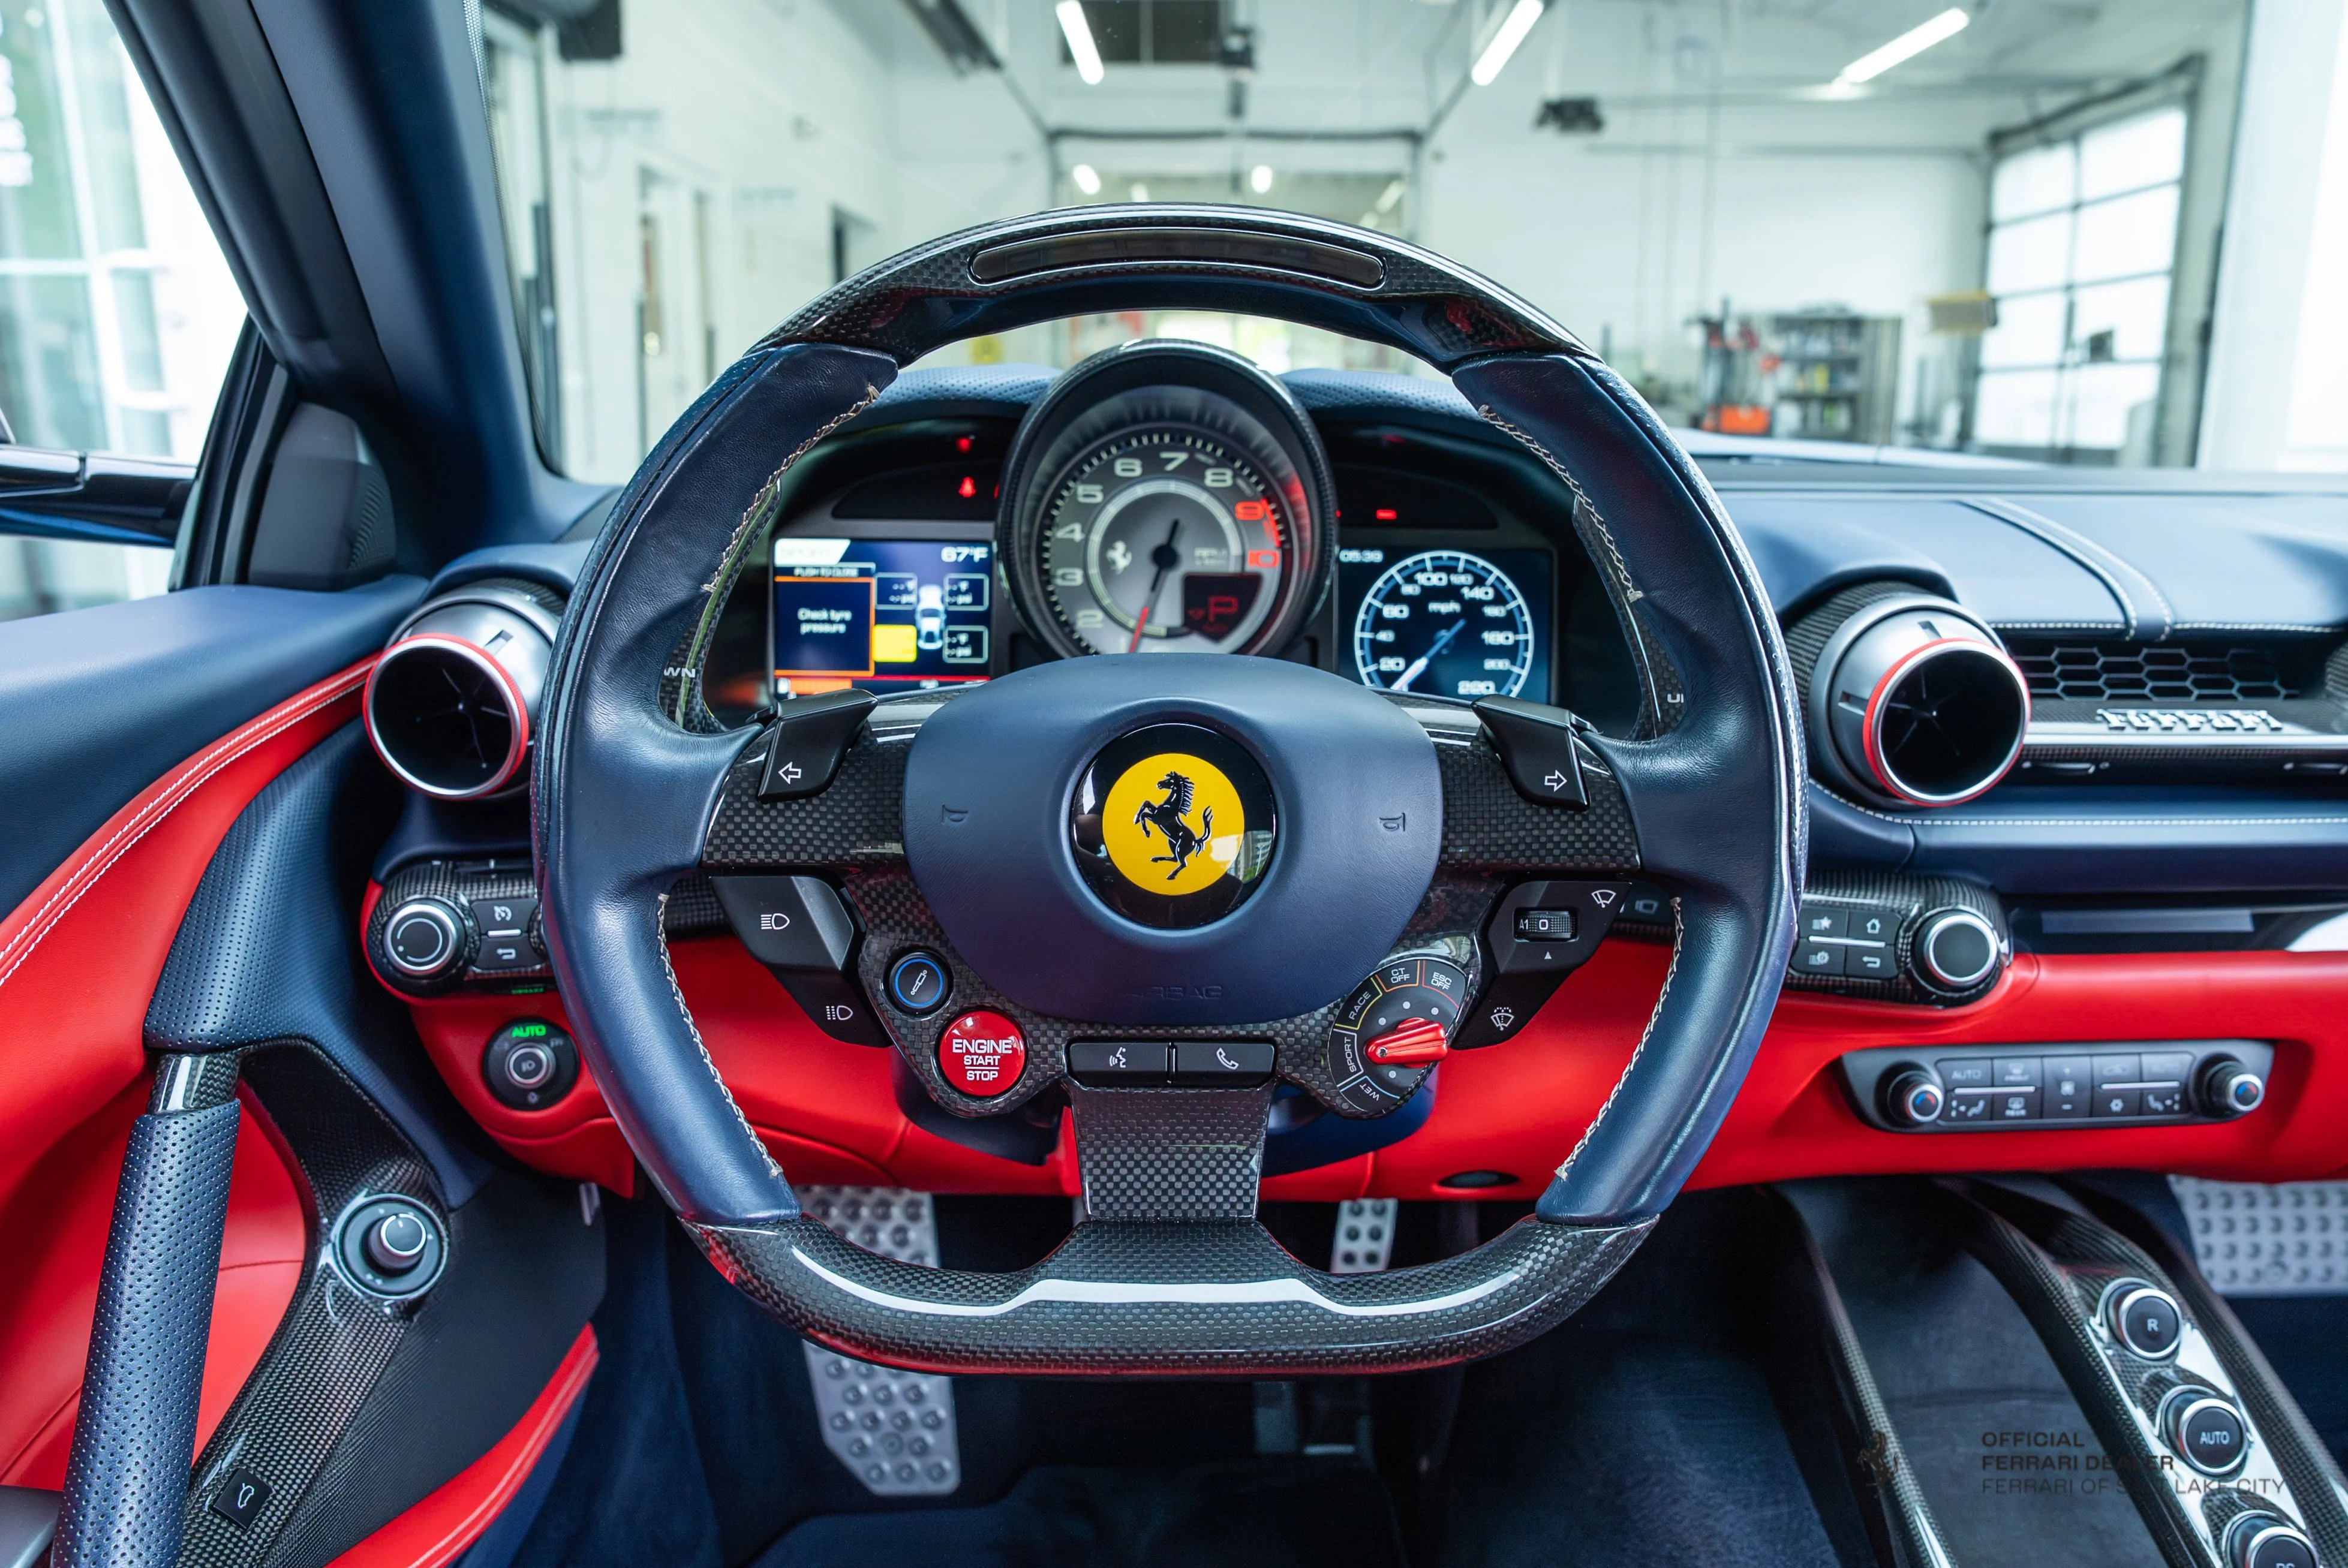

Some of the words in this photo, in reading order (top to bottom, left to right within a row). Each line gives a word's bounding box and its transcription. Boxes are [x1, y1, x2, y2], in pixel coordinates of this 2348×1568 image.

[1114, 458, 1143, 477] 6
[1160, 452, 1189, 471] 7
[1204, 468, 1233, 488] 8
[1076, 484, 1104, 504] 5
[1235, 501, 1264, 520] 9
[1056, 523, 1086, 542] 4
[1054, 567, 1084, 586] 3
[1414, 571, 1448, 586] 100
[1460, 586, 1495, 600] 140
[798, 607, 829, 621] Check
[829, 609, 852, 622] tyre
[1208, 596, 1238, 622] P
[1382, 604, 1409, 618] 60
[1428, 600, 1462, 615] mph
[1078, 609, 1104, 628] 2
[800, 622, 847, 635] pressure
[1481, 631, 1516, 646] 180
[1379, 657, 1405, 672] 20
[1457, 681, 1495, 695] 220
[1390, 974, 1410, 983] OFF
[1391, 968, 1406, 976] CT
[1433, 971, 1452, 985] ESC
[1431, 979, 1450, 991] OFF
[1349, 991, 1371, 1020] RACE
[512, 1024, 546, 1038] AUTO
[952, 1039, 1012, 1054] ENGINE
[964, 1056, 1000, 1066] START
[1344, 1037, 1357, 1073] SPORT
[966, 1071, 998, 1081] STOP
[1359, 1083, 1380, 1101] WET
[2146, 1319, 2158, 1332] R
[2199, 1431, 2230, 1445] AUTO
